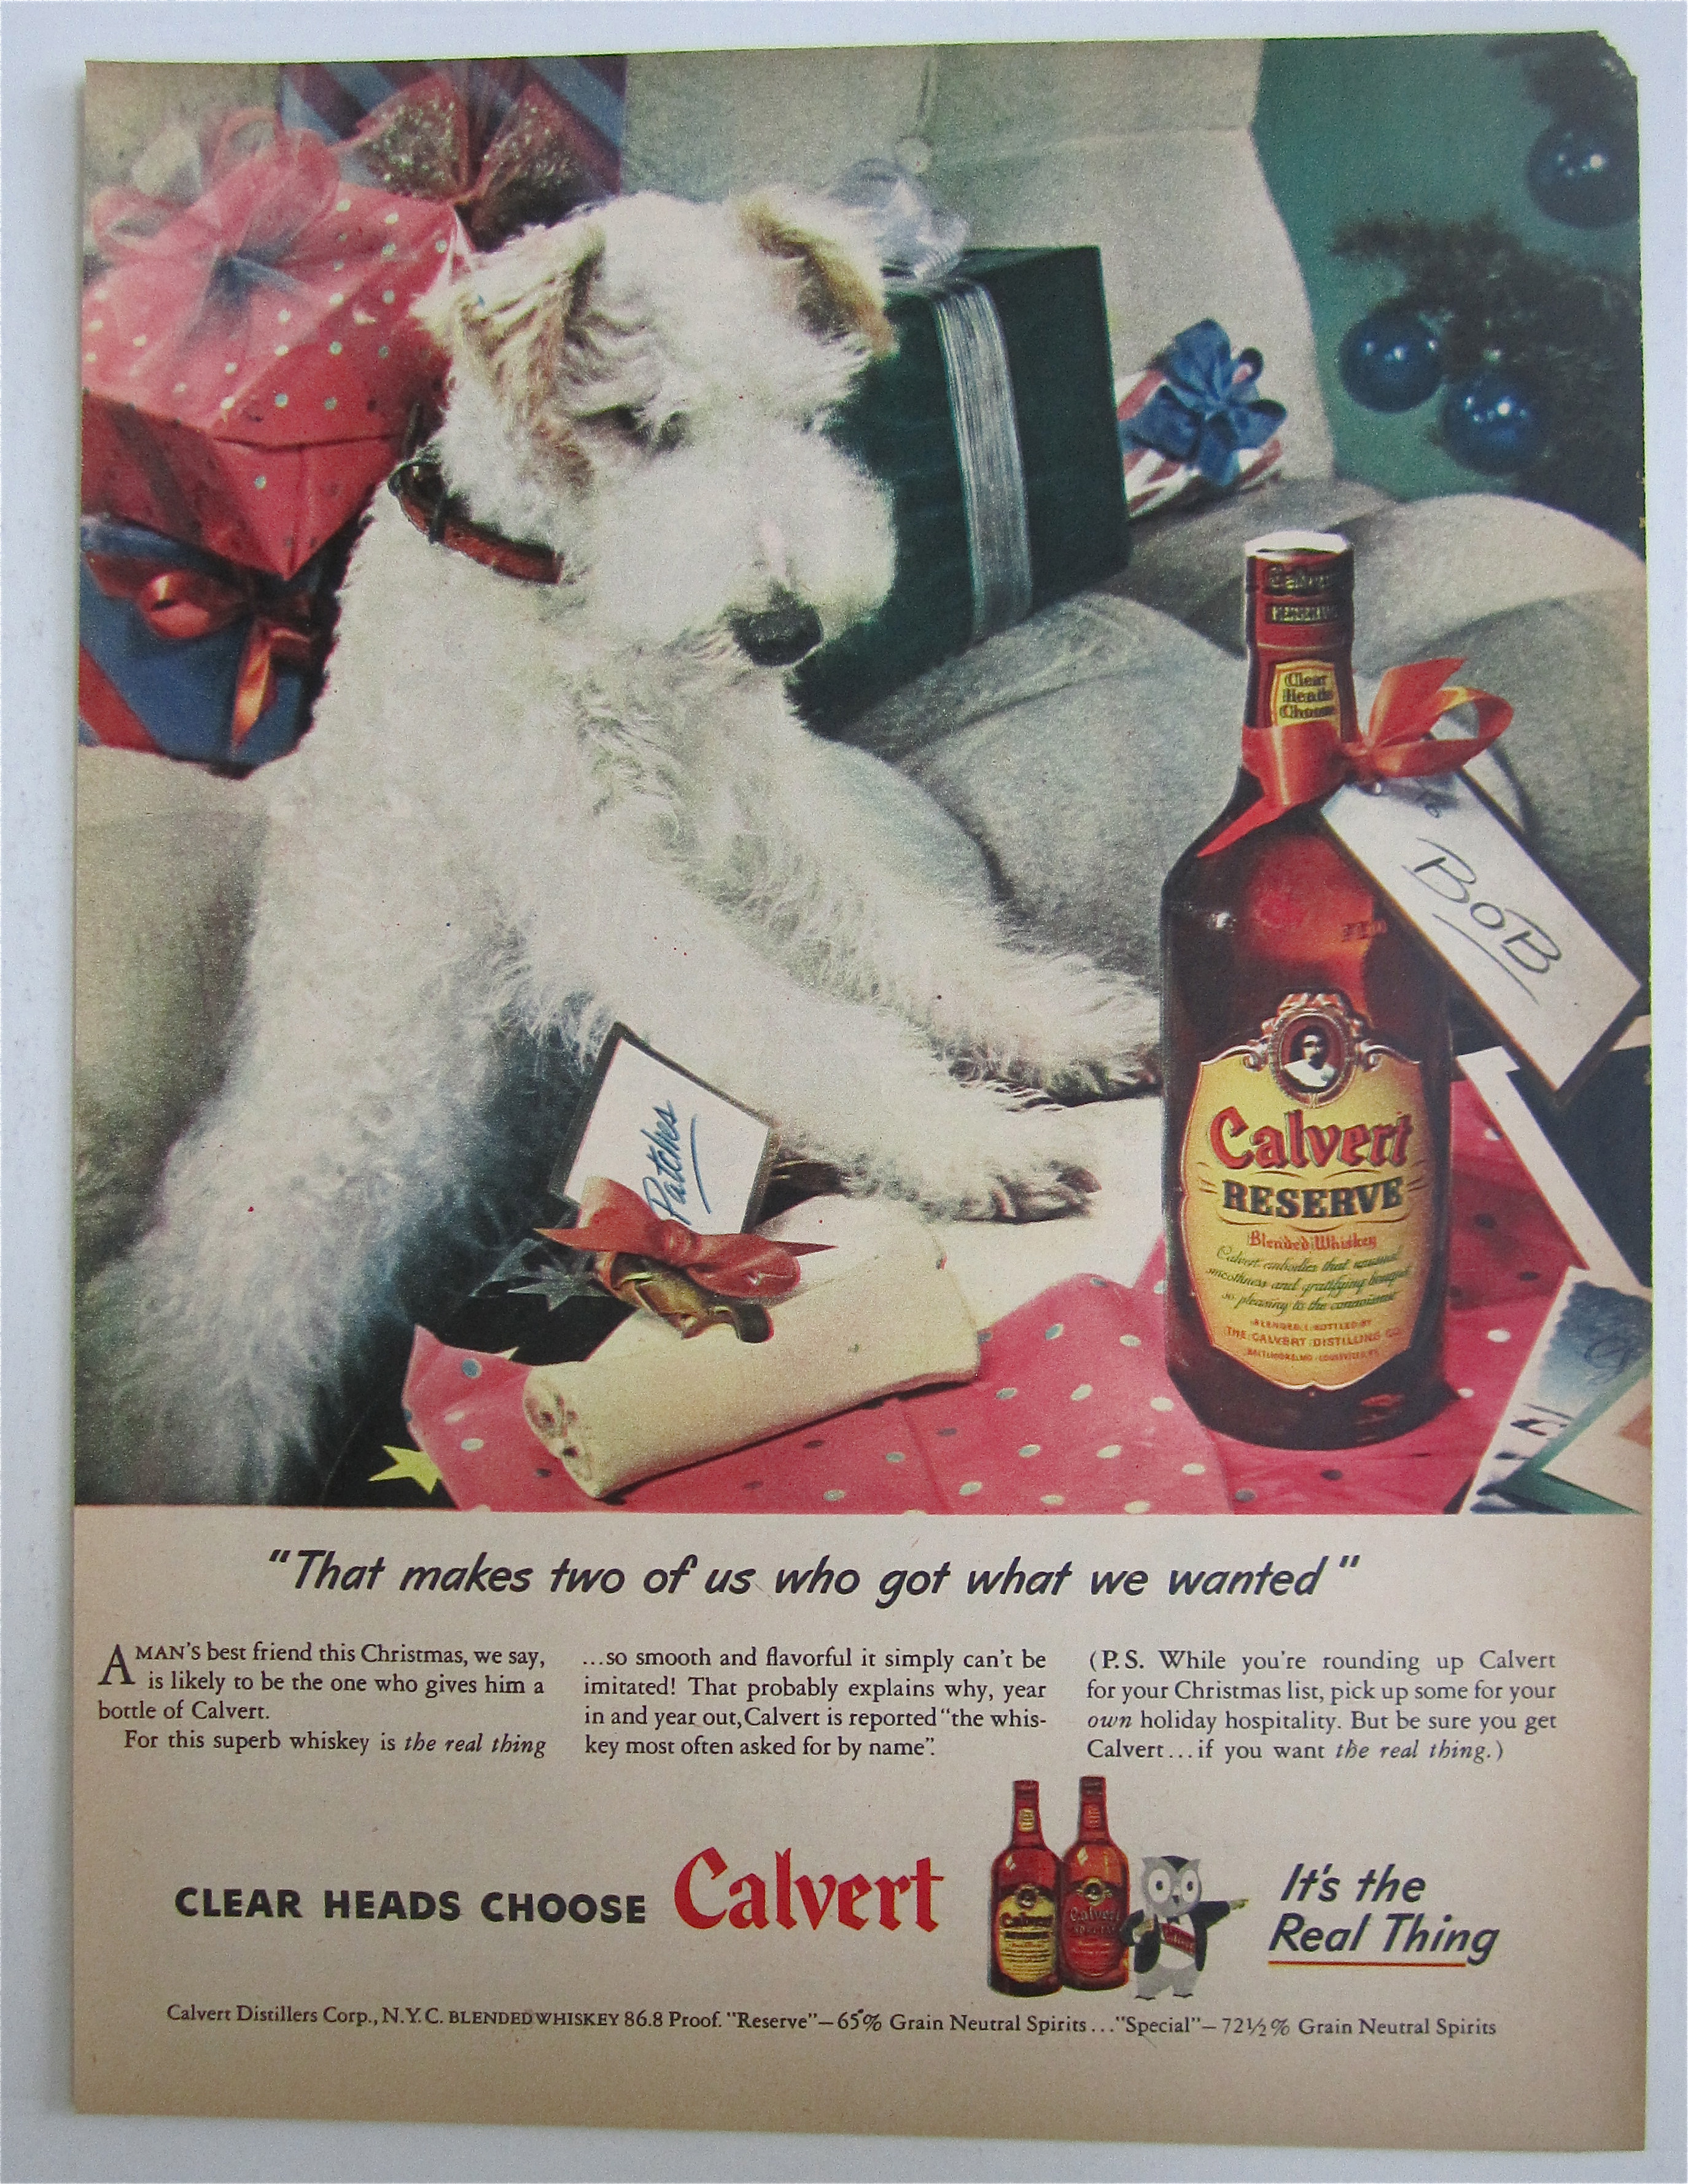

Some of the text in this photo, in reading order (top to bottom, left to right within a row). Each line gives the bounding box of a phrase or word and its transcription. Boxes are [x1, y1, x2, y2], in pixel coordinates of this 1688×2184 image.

[1209, 1106, 1414, 1170] Calvert
[640, 1099, 691, 1226] Patches
[1222, 1176, 1405, 1219] RESERVE
[1248, 1230, 1378, 1251] Blended Whiskey
[1271, 1278, 1302, 1291] and
[1226, 1326, 1247, 1340] THE
[1251, 1332, 1307, 1347] CALVERT
[1312, 1330, 1381, 1347] DISTILLING
[399, 1552, 534, 1593] makes
[550, 1558, 625, 1594] two
[643, 1554, 697, 1595] of
[704, 1568, 756, 1595] us
[775, 1555, 860, 1595] who
[875, 1561, 951, 1609] got
[967, 1556, 1073, 1596] what
[1090, 1569, 1149, 1596] we
[98, 1641, 545, 1685] A MAN’S best friend this Christmas, we say,
[636, 1647, 711, 1666] smooth
[720, 1646, 756, 1666] and
[766, 1646, 852, 1667] flavorful
[862, 1648, 876, 1667] it
[885, 1648, 954, 1674] simply
[963, 1649, 1013, 1668] can’t
[1022, 1649, 1046, 1668] be
[1158, 1650, 1226, 1669] While
[1242, 1650, 1306, 1675] you’re
[1323, 1649, 1420, 1676] rounding
[1437, 1657, 1464, 1675] up
[1479, 1649, 1555, 1669] Calvert
[149, 1670, 544, 1698] is likely to be the one who gives him a
[584, 1675, 1046, 1703] imitated! That probably explains why, year
[1087, 1679, 1556, 1706] for your Christmas list, pick up some for your
[98, 1699, 269, 1719] bottle of Calvert.
[585, 1705, 604, 1724] in
[611, 1705, 647, 1725] and
[655, 1712, 697, 1731] year
[702, 1712, 742, 1729] out,
[744, 1706, 820, 1726] Calvert
[827, 1707, 842, 1726] is
[849, 1706, 936, 1732] reported
[990, 1708, 1046, 1728] whis-
[1087, 1709, 1556, 1735] own holiday hospitality. But be sure you get
[125, 1729, 546, 1758] For this superb whiskey is the real thing
[585, 1734, 619, 1759] key
[626, 1741, 675, 1754] most
[681, 1735, 733, 1755] often
[740, 1735, 796, 1755] asked
[803, 1735, 831, 1755] for
[838, 1736, 862, 1761] by
[1224, 1746, 1262, 1764] you
[1274, 1746, 1324, 1758] want
[1336, 1739, 1369, 1758] the
[1380, 1739, 1419, 1758] real
[1429, 1739, 1503, 1763] thing.)
[175, 1846, 945, 1933] CLEAR HEADS CHOOSE Calvert
[1280, 1863, 1426, 1903] It’s the
[1268, 1913, 1500, 1966] Real Thing
[167, 2004, 230, 2021] Calvert
[236, 2005, 317, 2023] Distillers
[323, 2006, 378, 2027] Corp.,
[449, 2011, 532, 2025] BLENDED
[532, 2012, 619, 2027] WHISKEY
[624, 2011, 663, 2027] 86.8
[669, 2010, 722, 2028] Proof.
[890, 2014, 944, 2031] Grain
[950, 2015, 1021, 2032] Neutral
[1297, 2018, 1353, 2035] Grain
[1359, 2018, 1430, 2035] Neutral
[1437, 2018, 1496, 2038] Spirits
